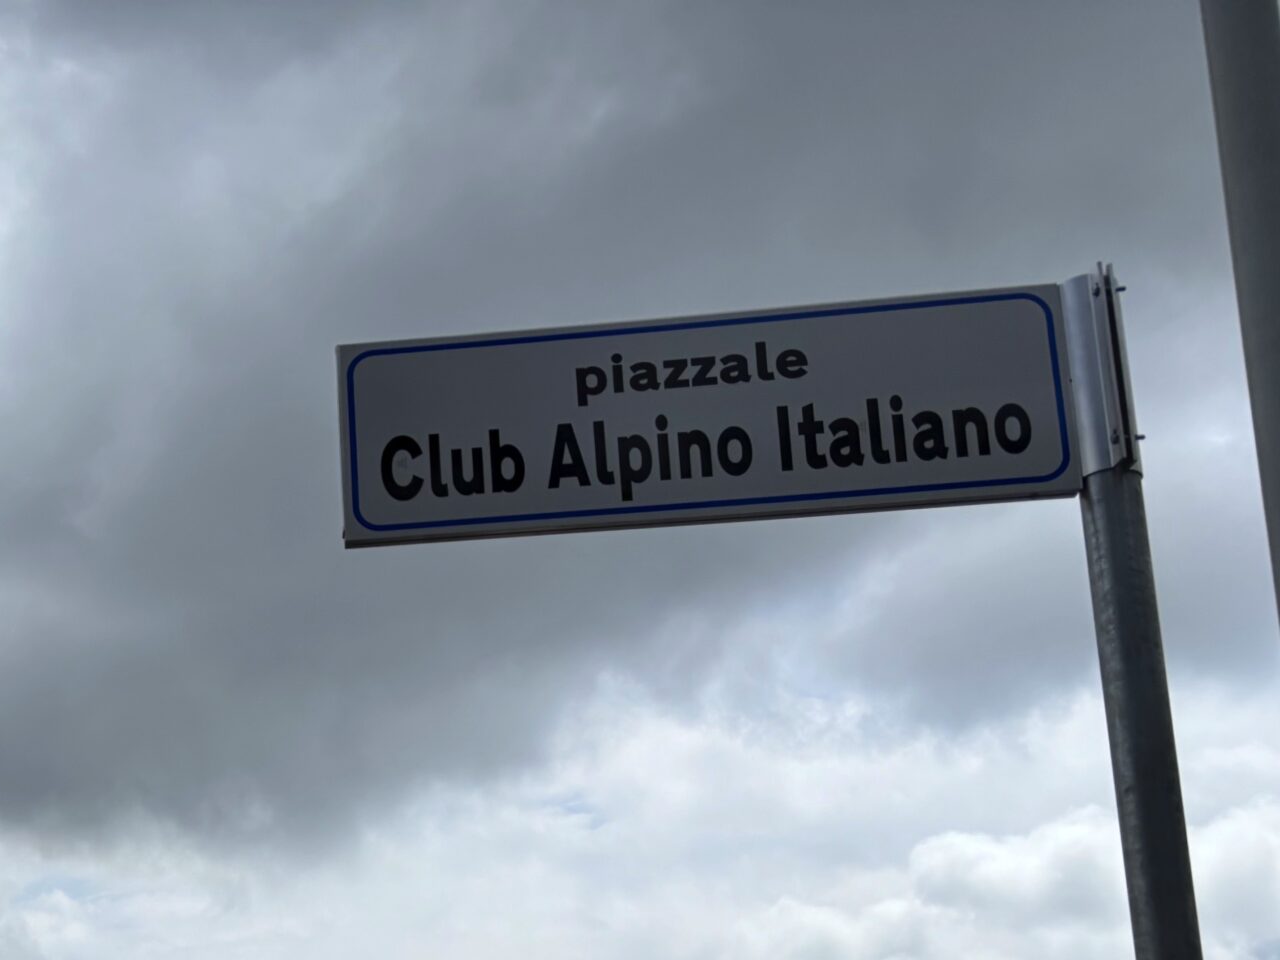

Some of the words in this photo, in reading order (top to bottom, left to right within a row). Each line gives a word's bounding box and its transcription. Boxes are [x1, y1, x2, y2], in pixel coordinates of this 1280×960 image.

[575, 341, 809, 406] piazzale
[380, 429, 525, 502] Club
[548, 414, 752, 501] Alpino
[776, 394, 1032, 471] Italiano
